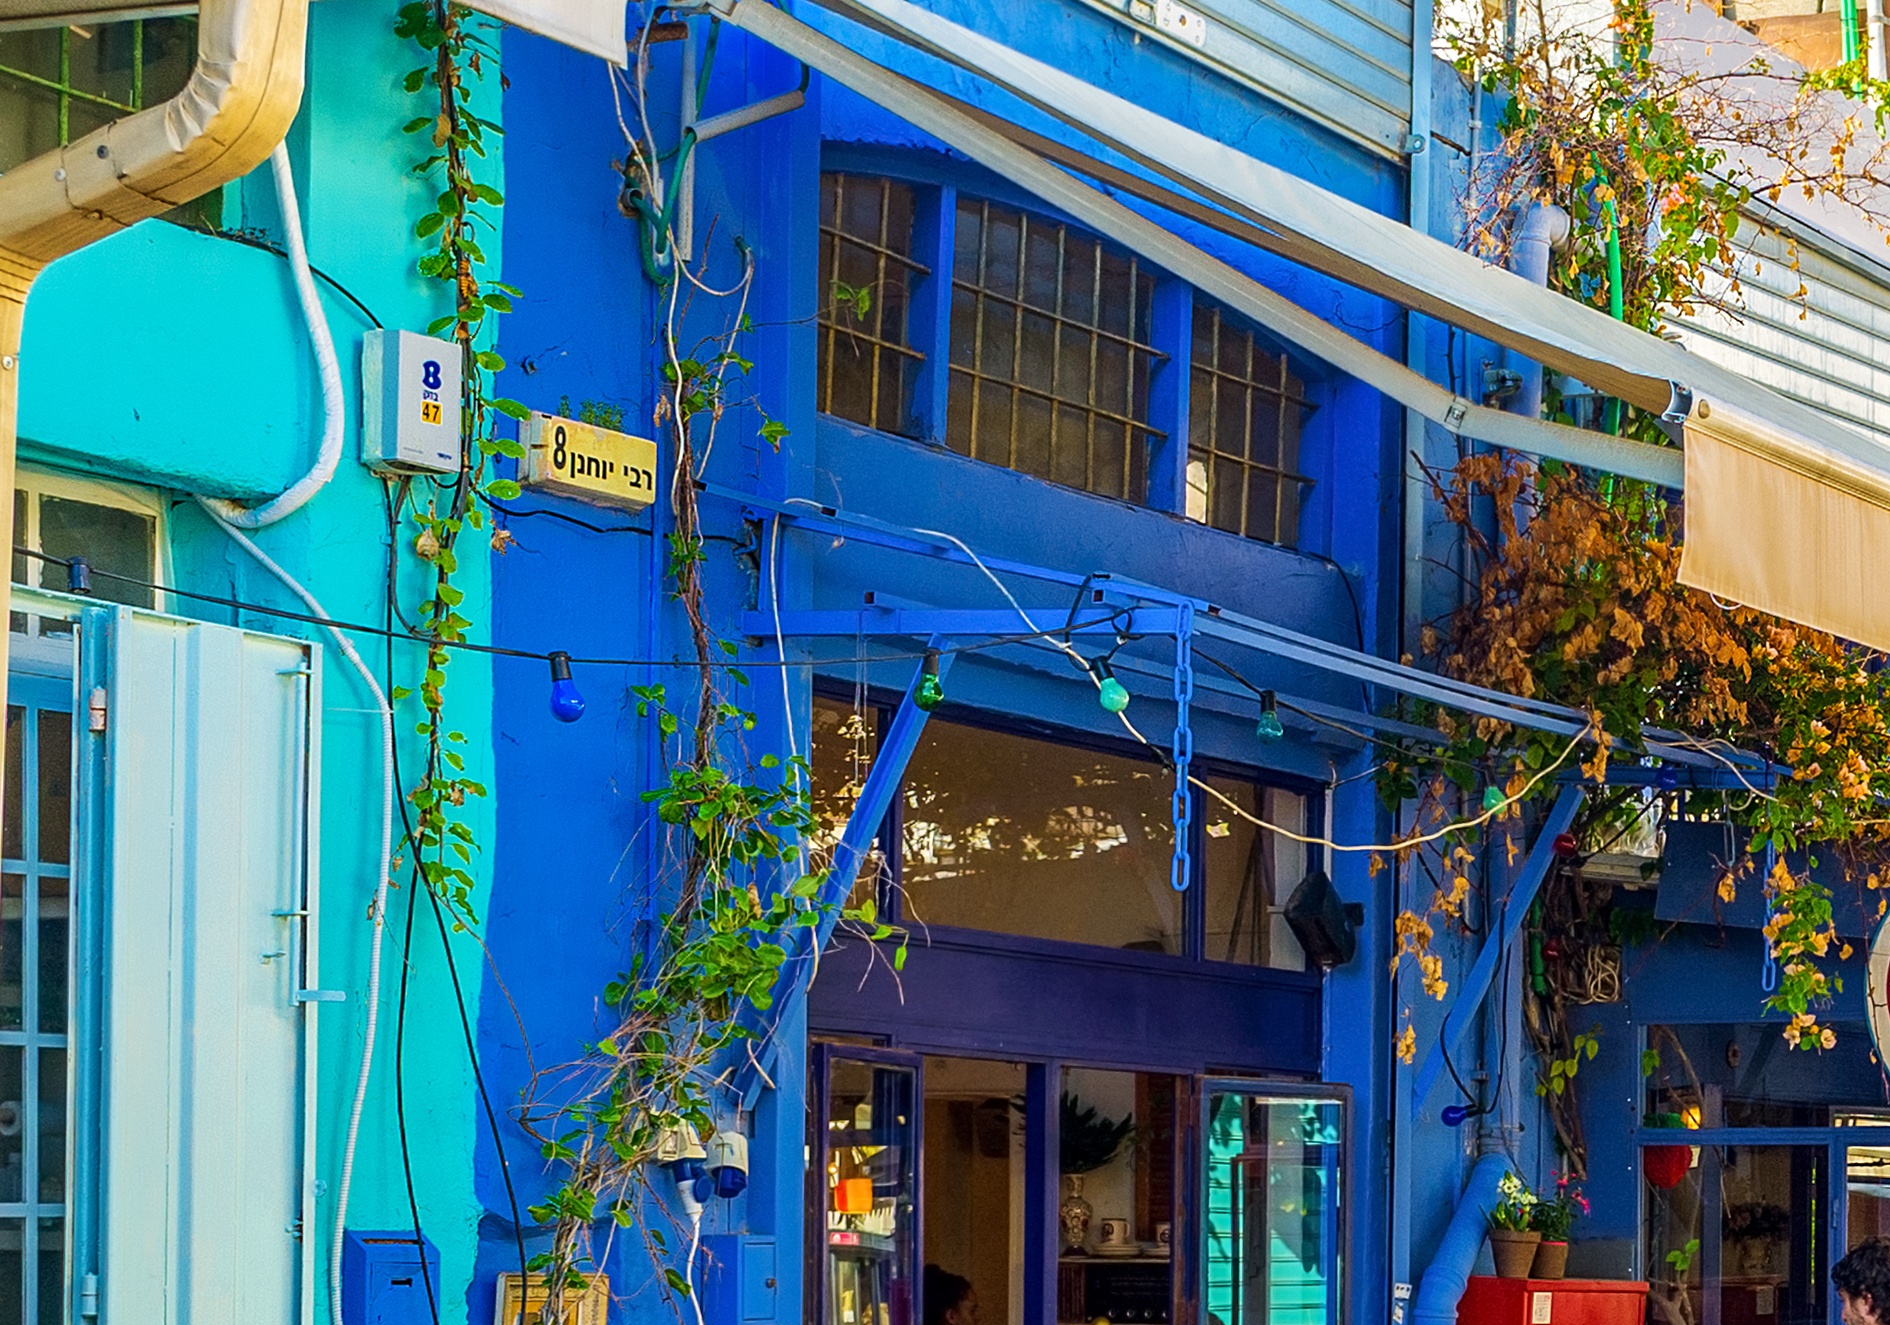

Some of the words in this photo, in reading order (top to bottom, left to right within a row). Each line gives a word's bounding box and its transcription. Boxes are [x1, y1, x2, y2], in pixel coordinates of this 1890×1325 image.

[422, 390, 438, 402] בזק
[422, 403, 441, 422] 47
[553, 425, 567, 470] 8
[569, 451, 614, 480] יוחנן
[623, 465, 653, 491] רבי
